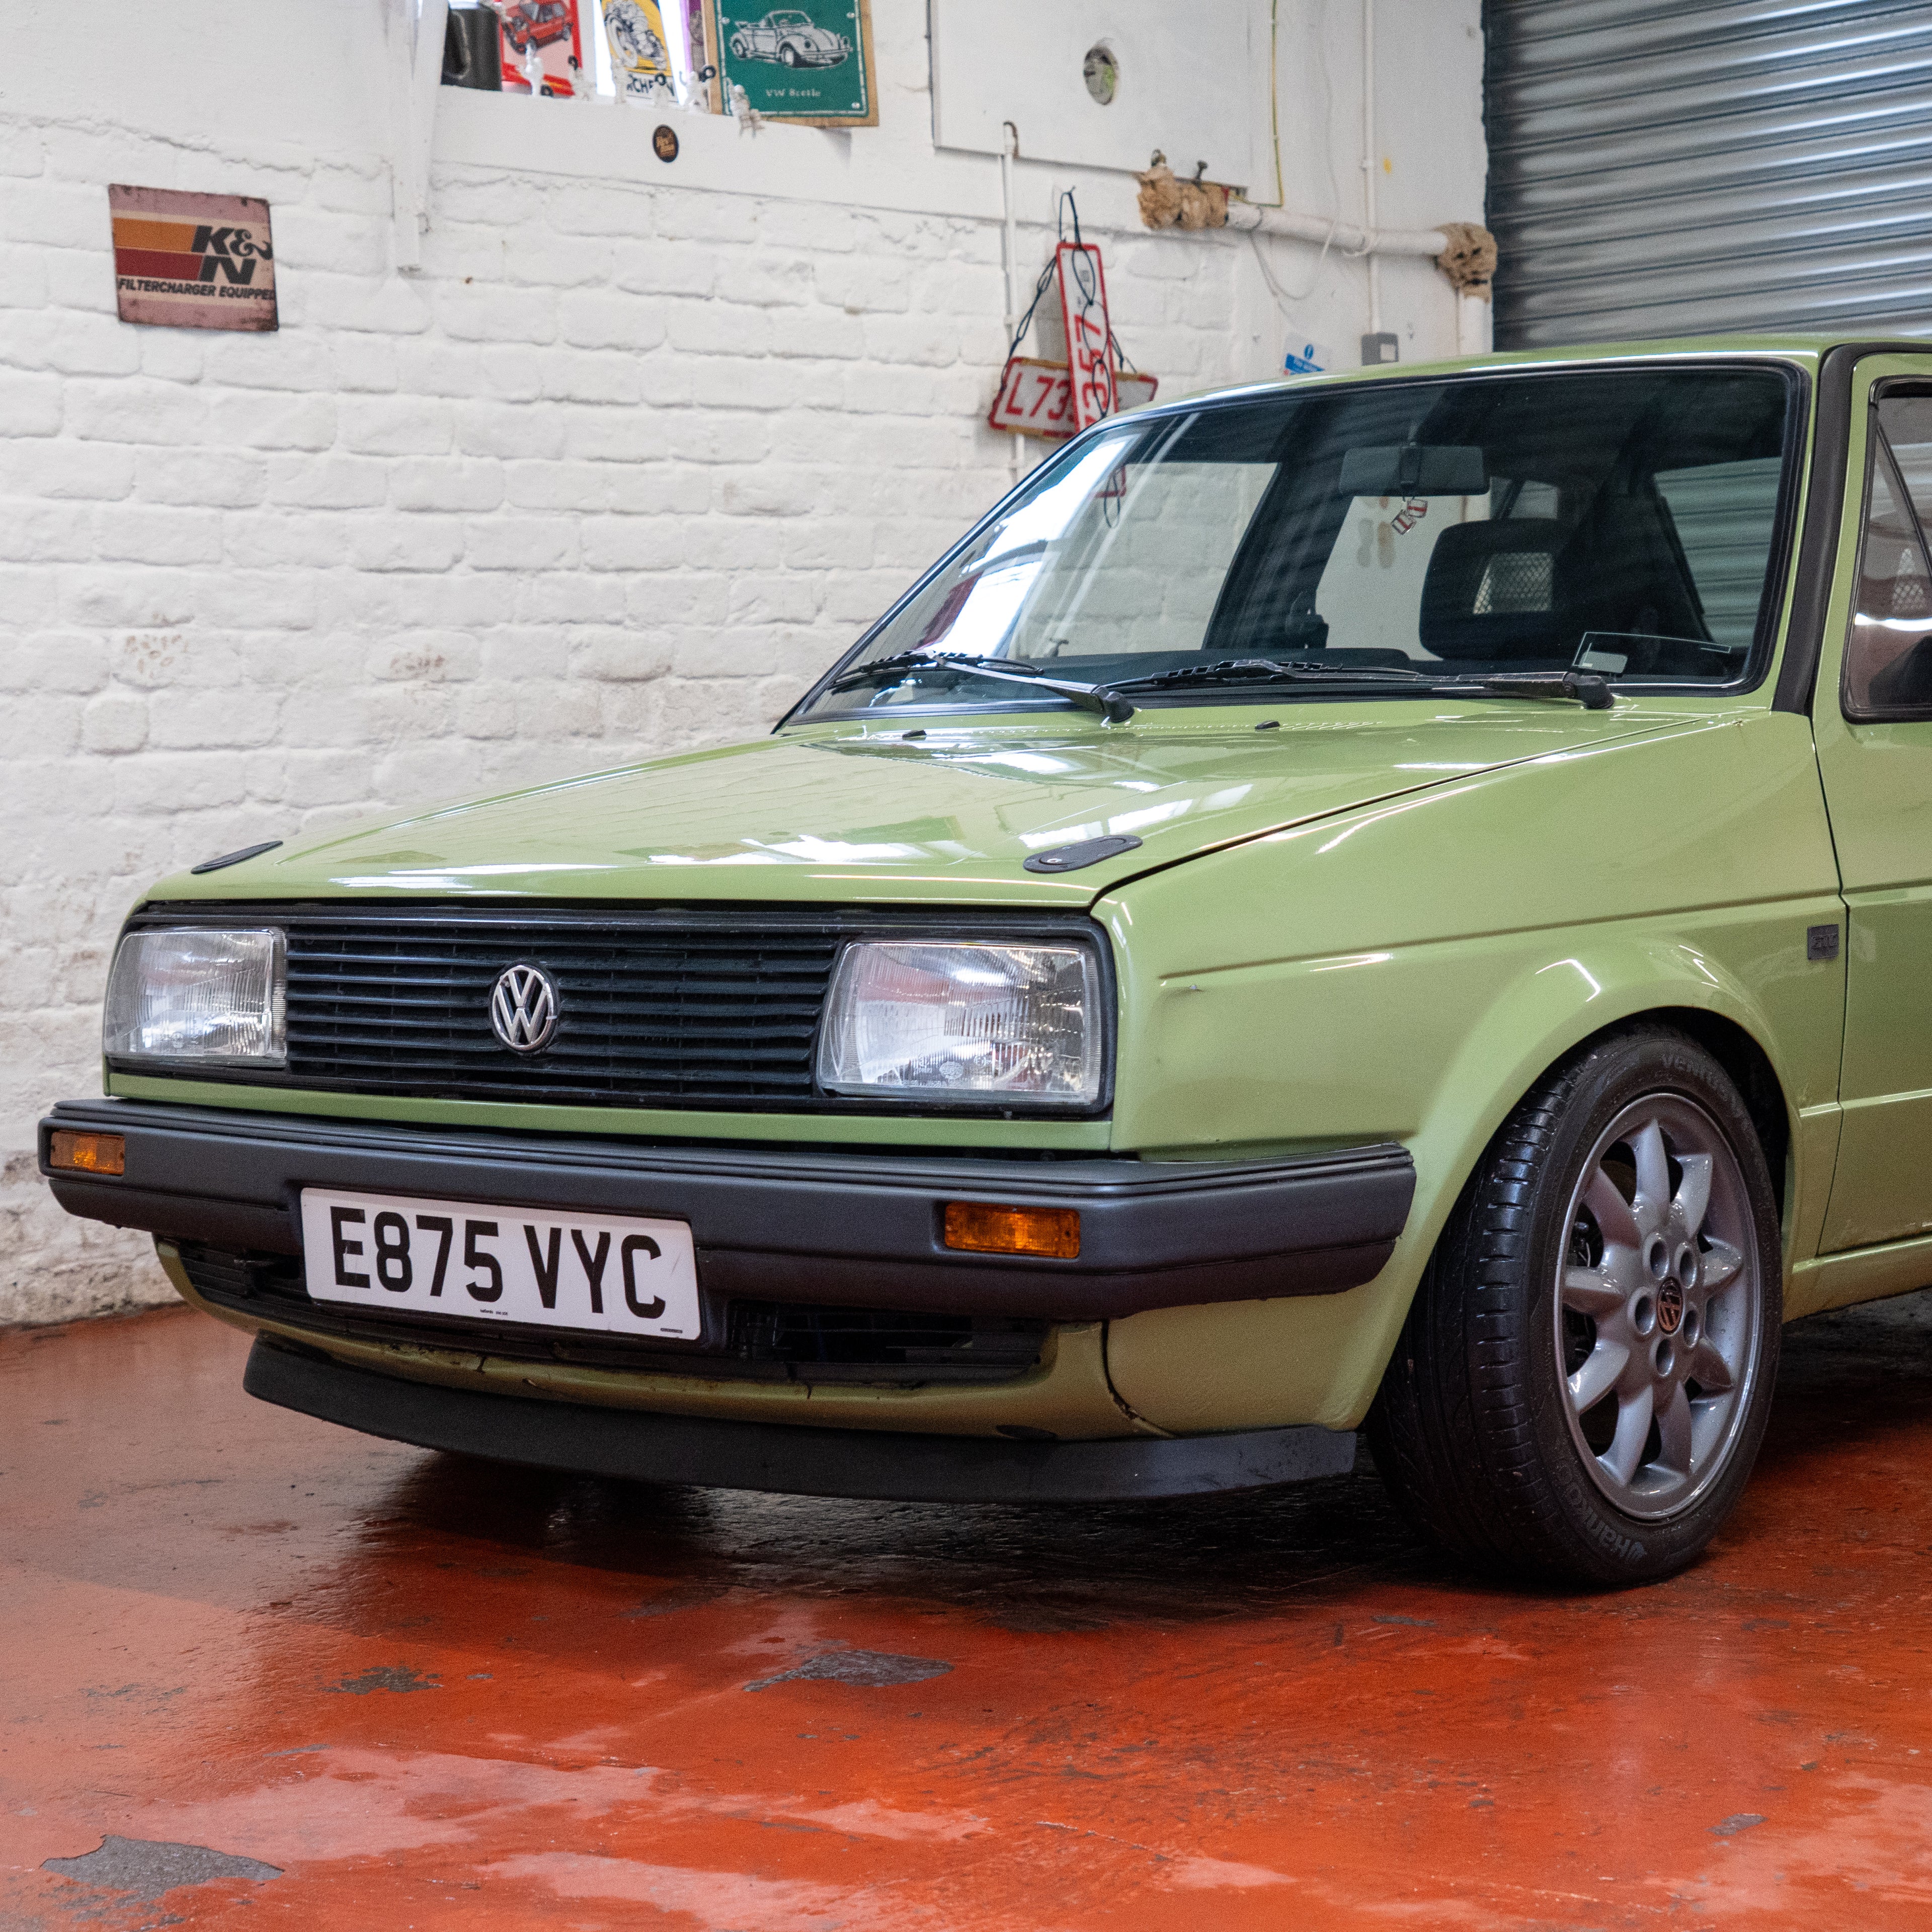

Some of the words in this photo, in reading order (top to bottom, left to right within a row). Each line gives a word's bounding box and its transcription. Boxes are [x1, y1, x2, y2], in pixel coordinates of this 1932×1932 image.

[765, 89, 786, 97] VW
[788, 88, 821, 97] Beetle
[117, 278, 217, 297] FILTERCHARGER
[330, 1205, 503, 1303] E875
[523, 1224, 667, 1320] VYC
